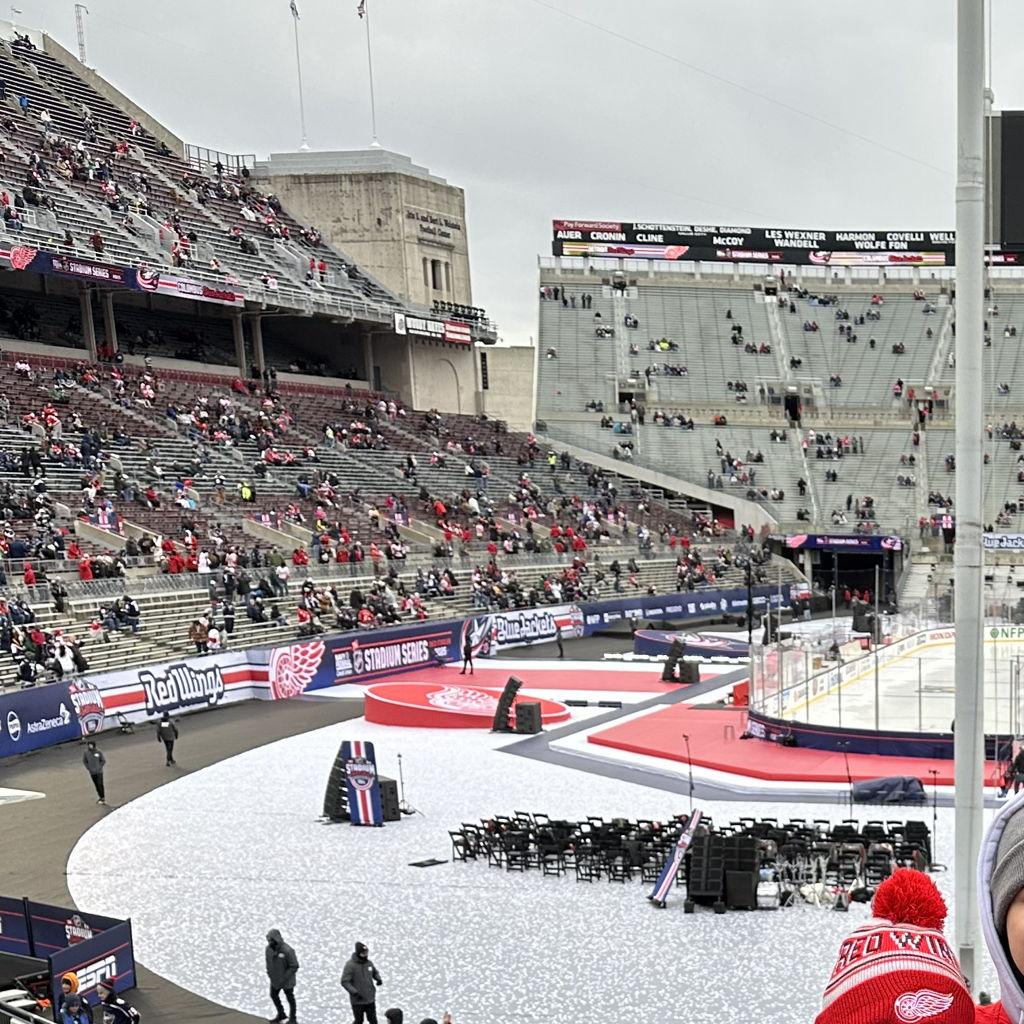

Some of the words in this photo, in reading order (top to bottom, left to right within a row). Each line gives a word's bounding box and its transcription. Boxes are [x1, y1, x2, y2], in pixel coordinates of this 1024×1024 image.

[557, 231, 582, 240] AUER
[591, 232, 626, 241] CRONIN
[636, 233, 664, 243] CLINE
[765, 230, 782, 239] LES
[785, 231, 826, 240] WEXNER
[836, 233, 875, 241] HARMON
[887, 233, 924, 241] COVELLI
[713, 236, 744, 246] McCOY
[774, 239, 819, 248] WANDELL
[855, 241, 887, 249] WOLFE
[1001, 628, 1024, 638] NFP
[364, 644, 401, 672] STADIUM
[401, 640, 429, 664] SERIES
[27, 716, 63, 734] AstraZeneca
[76, 955, 117, 994] ESPN
